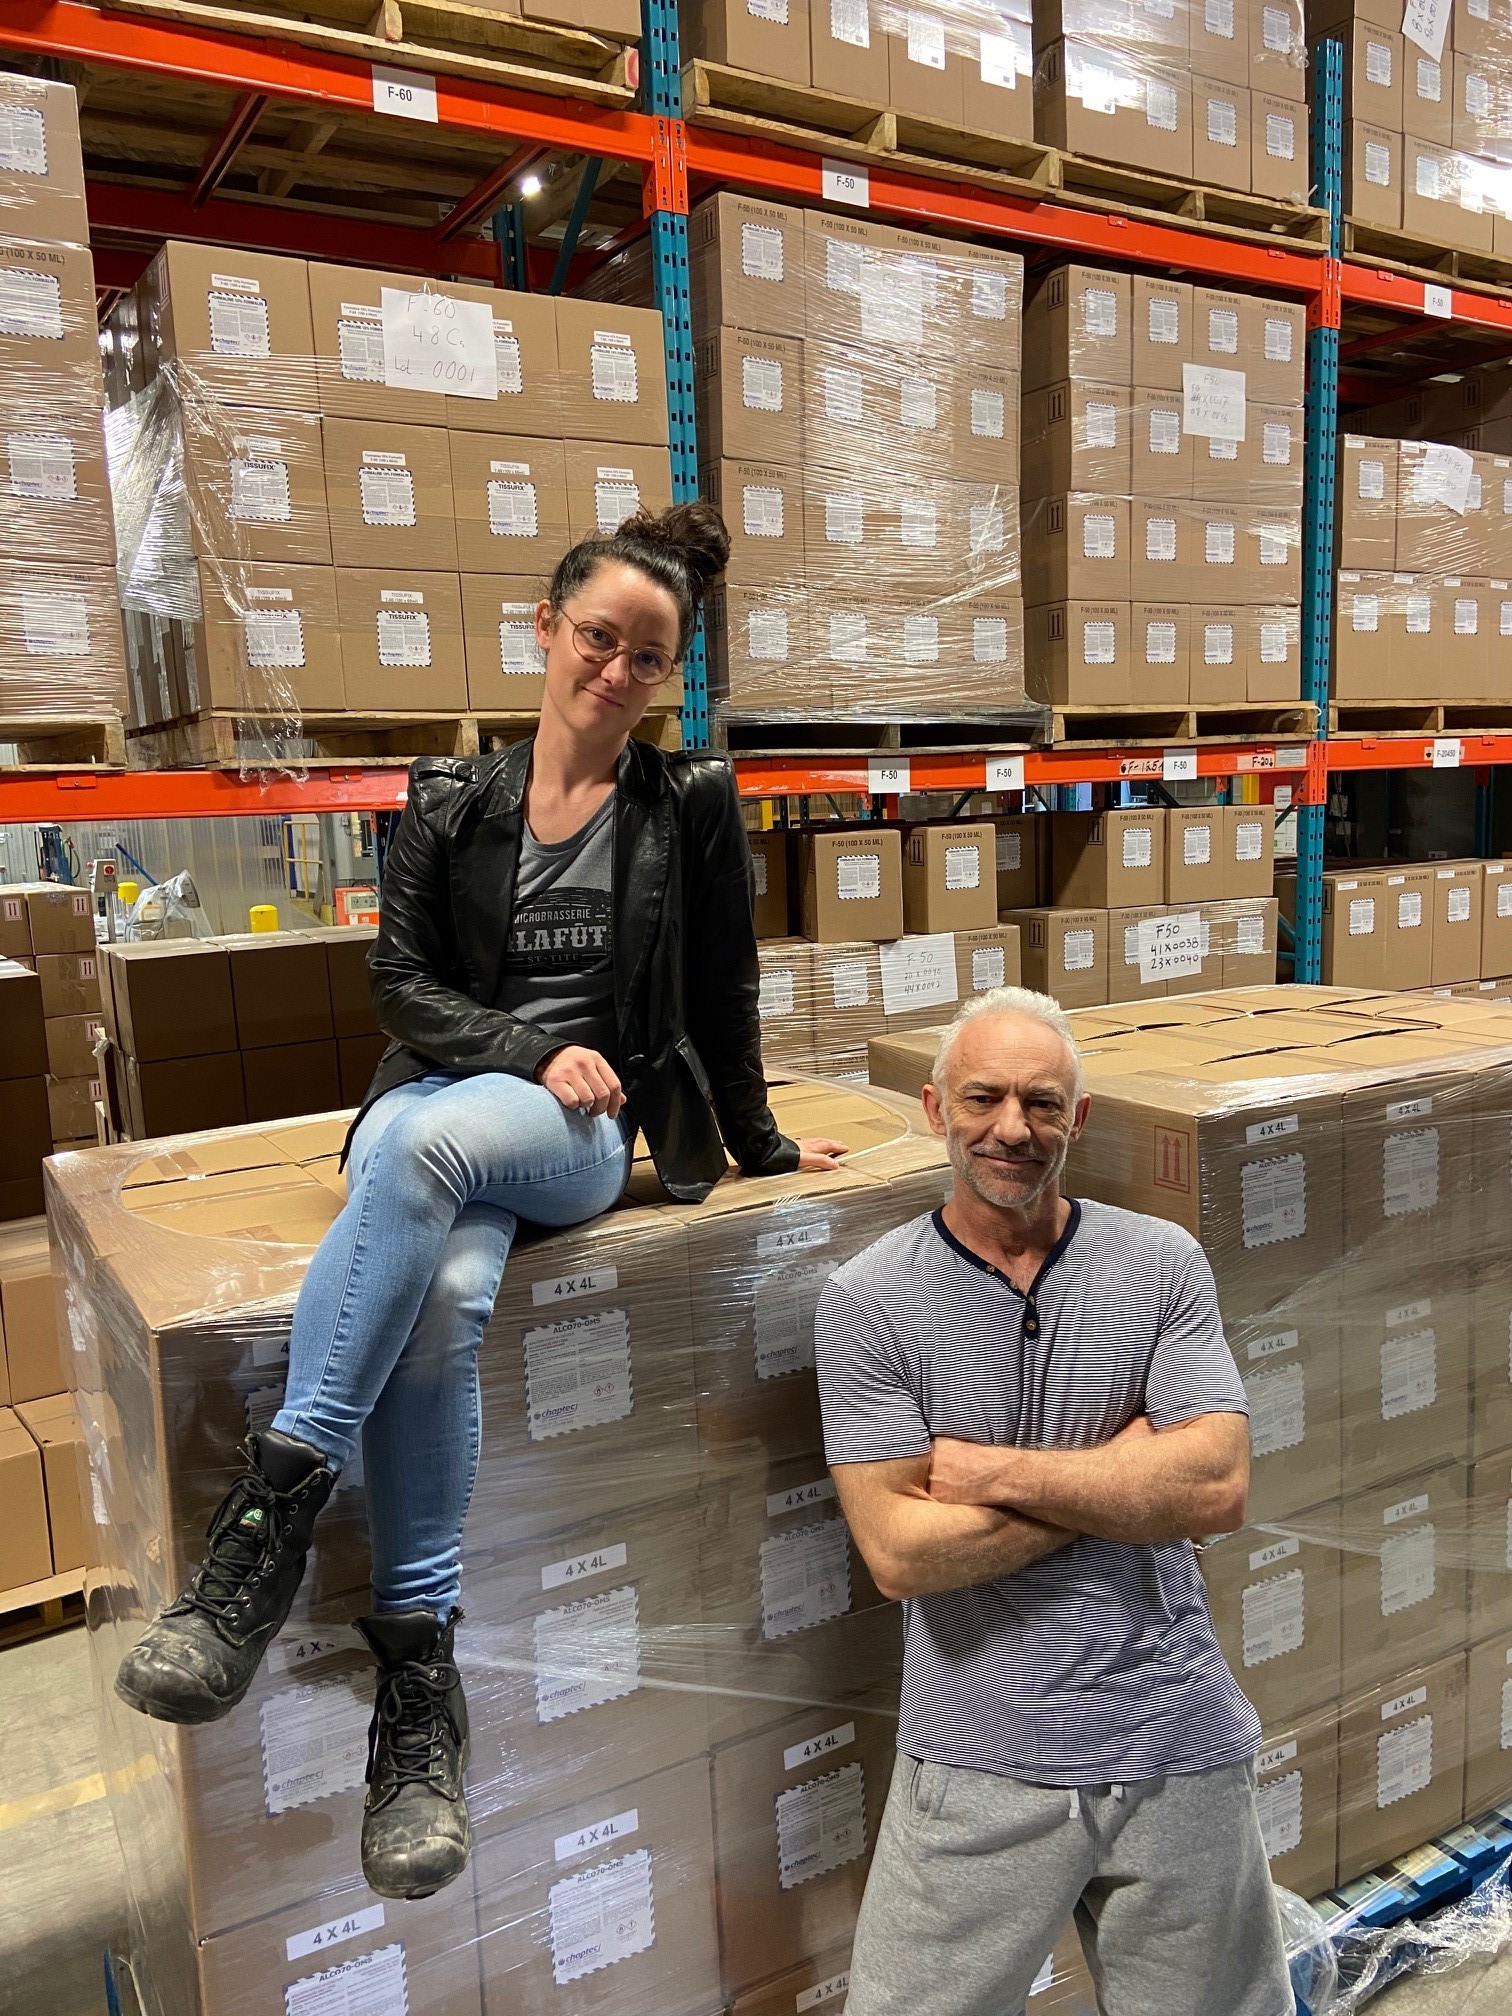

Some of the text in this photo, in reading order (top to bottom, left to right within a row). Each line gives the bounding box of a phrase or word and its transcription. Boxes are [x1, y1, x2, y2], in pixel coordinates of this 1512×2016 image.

[387, 85, 413, 102] F-60
[836, 175, 855, 189] F-50
[737, 203, 788, 222] F-50 (100 X 50 ML)
[821, 219, 868, 237] F-50 (100 X 50 ML)
[36, 252, 47, 261] 50
[1432, 297, 1444, 307] F-50
[243, 461, 275, 470] TISSUFIX
[497, 483, 525, 491] TISSUFIX
[388, 613, 417, 621] TISSUFIX
[996, 768, 1012, 778] F-50
[1173, 760, 1188, 770] F-50
[881, 770, 898, 780] F-50
[1155, 923, 1180, 939] F50
[1259, 1122, 1286, 1136] 4 X 4L
[776, 1231, 812, 1247] 4 X 4L
[554, 1277, 597, 1296] 4 X 4L
[553, 1317, 601, 1334] ALCO70-OMS
[1260, 1337, 1286, 1352] 4 X 4L
[541, 1402, 578, 1418] chaptec
[785, 1486, 822, 1506] 4 X 4L
[1395, 1502, 1418, 1517] 4 X 4L
[1262, 1546, 1287, 1562] 4 X 4L
[565, 1555, 607, 1577] 4 X 4L
[563, 1595, 611, 1616] ALCO70-OMS
[296, 1640, 322, 1658] 4 X
[549, 1681, 586, 1699] chaptec
[1393, 1695, 1416, 1712] 4 X 4L
[803, 1734, 839, 1757] 4 X 4L
[1260, 1750, 1285, 1767] 4 X 4L
[800, 1772, 841, 1794] ALCO70-OMS
[577, 1823, 619, 1847] 4 X 4L
[577, 1859, 624, 1883] ALCO70-OMS
[312, 1919, 362, 1945] 4 X 4L
[565, 1943, 601, 1964] chaptec
[318, 1956, 373, 1983] ALCO70-OMS
[815, 1977, 849, 1999] 4 X 4L
